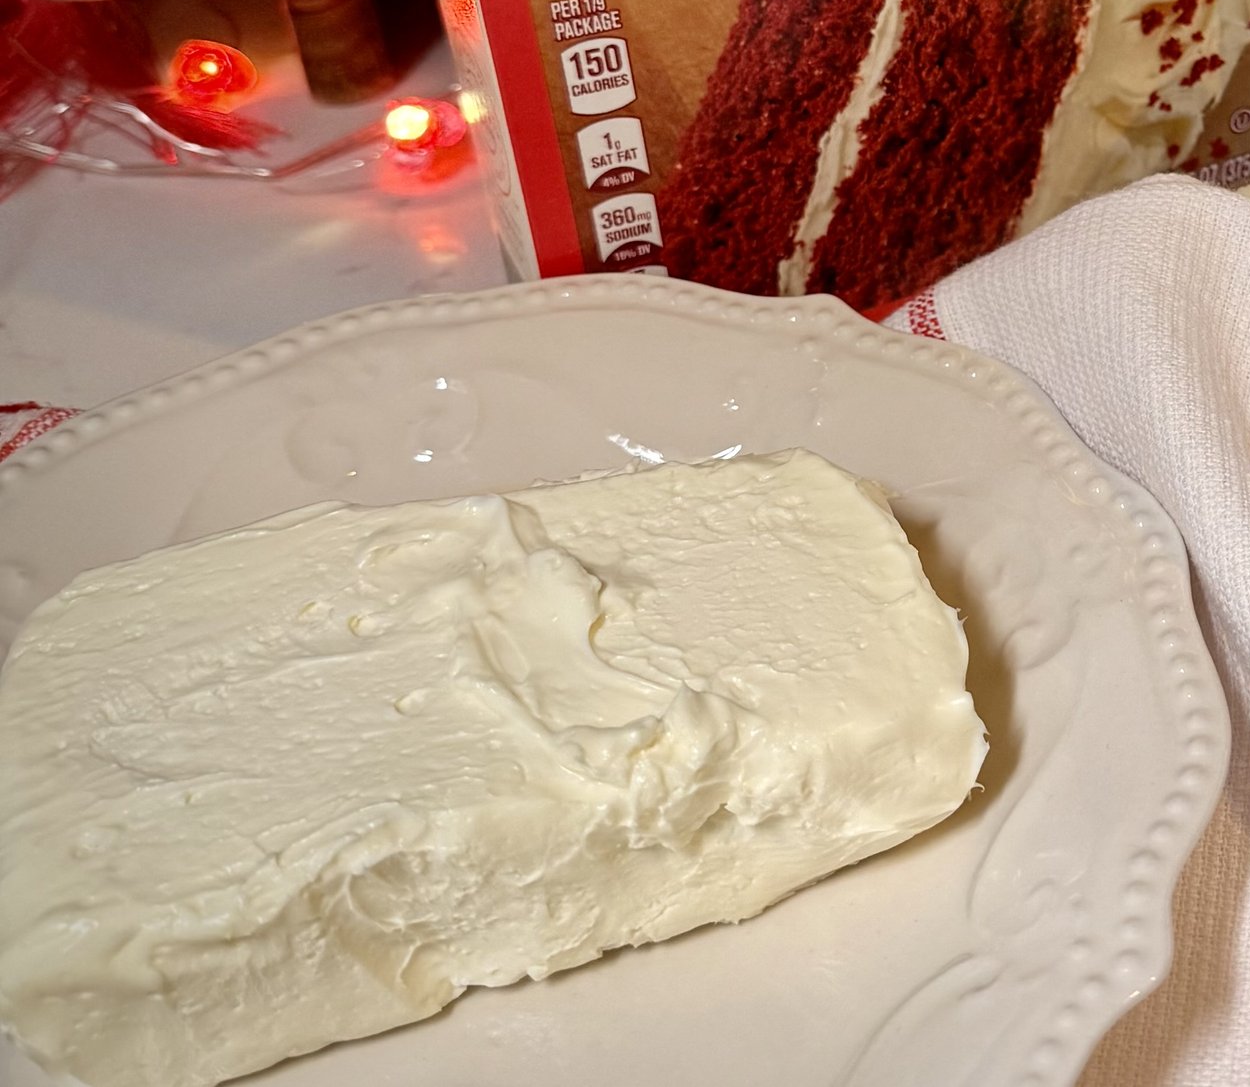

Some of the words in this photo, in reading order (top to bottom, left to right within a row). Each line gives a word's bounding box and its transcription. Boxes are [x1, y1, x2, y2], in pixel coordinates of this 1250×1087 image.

[554, 10, 622, 41] PACKAGE
[569, 44, 623, 80] 150
[571, 74, 630, 97] CALORIES
[591, 154, 614, 169] SAT
[617, 148, 638, 163] FAT
[602, 176, 620, 187] 4%
[621, 171, 635, 183] DV
[606, 223, 653, 244] SODIUM
[638, 244, 652, 255] DV
